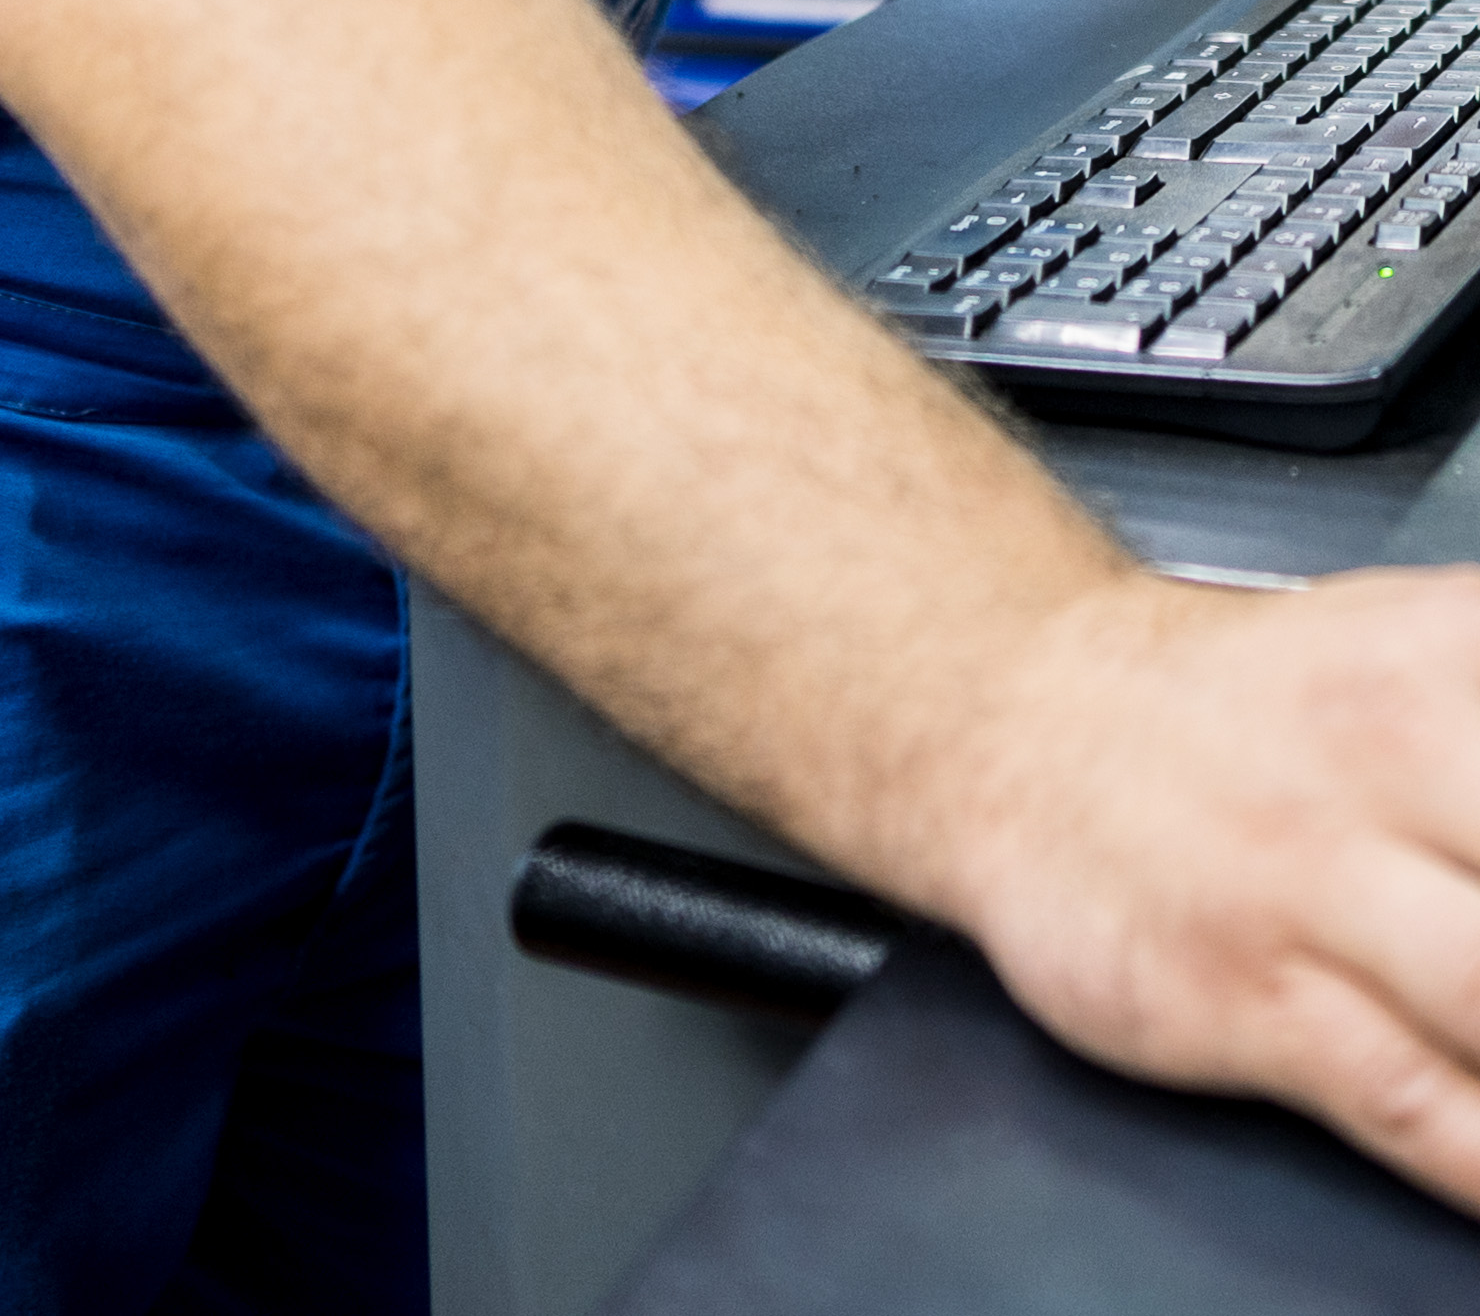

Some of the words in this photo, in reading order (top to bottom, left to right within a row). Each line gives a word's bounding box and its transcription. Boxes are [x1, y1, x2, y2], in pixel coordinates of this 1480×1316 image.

[1221, 230, 1241, 239] 7
[1030, 247, 1052, 257] 2
[1109, 252, 1130, 263] 5
[1189, 256, 1211, 267] 8
[998, 271, 1020, 282] 3
[1076, 277, 1099, 288] 6
[1158, 281, 1182, 293] 9
